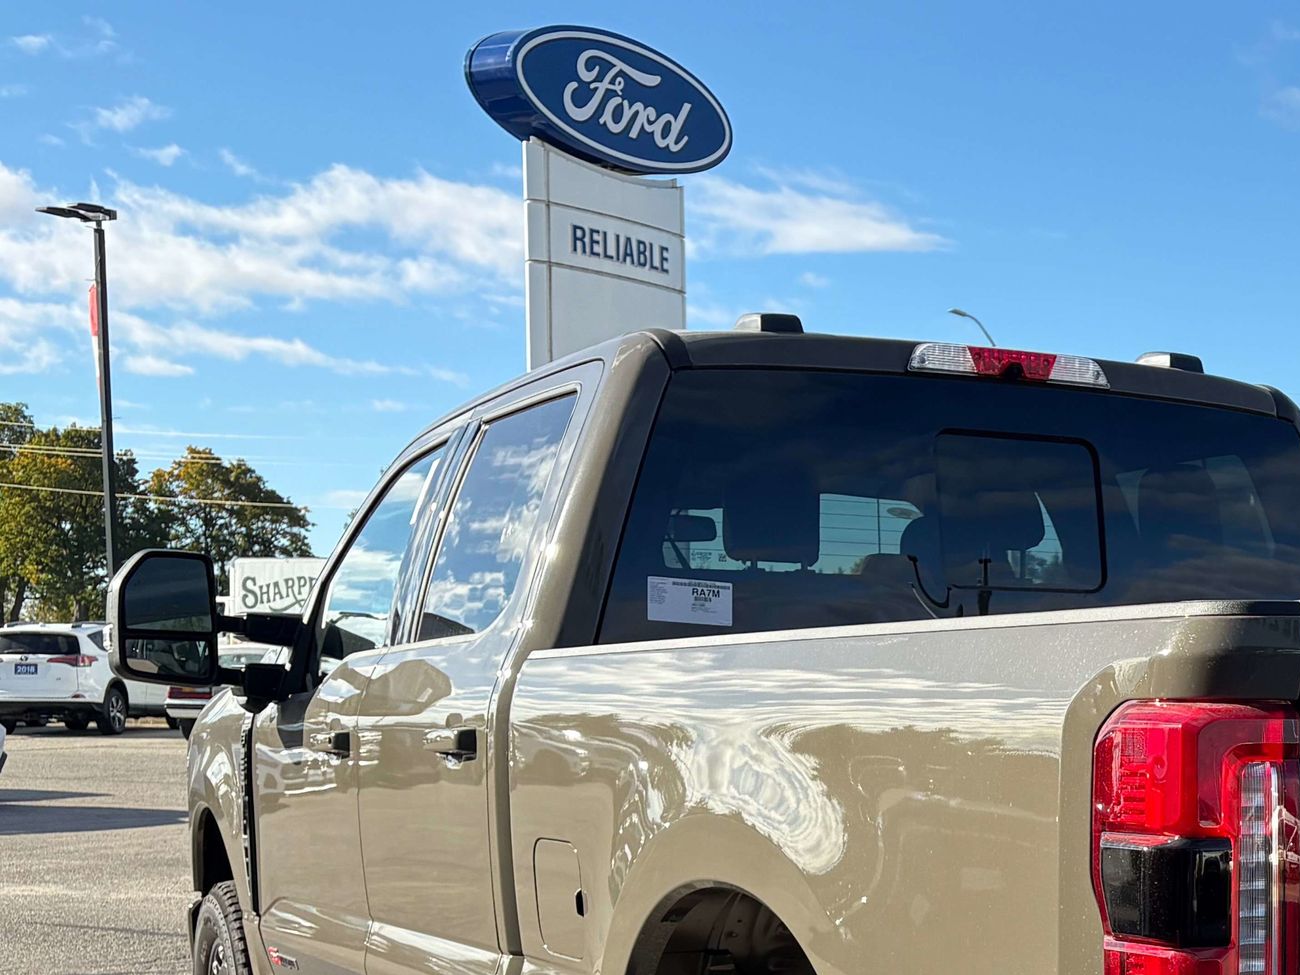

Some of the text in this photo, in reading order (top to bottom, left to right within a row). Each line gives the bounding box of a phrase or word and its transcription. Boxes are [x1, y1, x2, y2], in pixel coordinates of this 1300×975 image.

[562, 49, 692, 153] Ford
[571, 224, 670, 274] RELIABLE
[691, 587, 721, 599] RA7M
